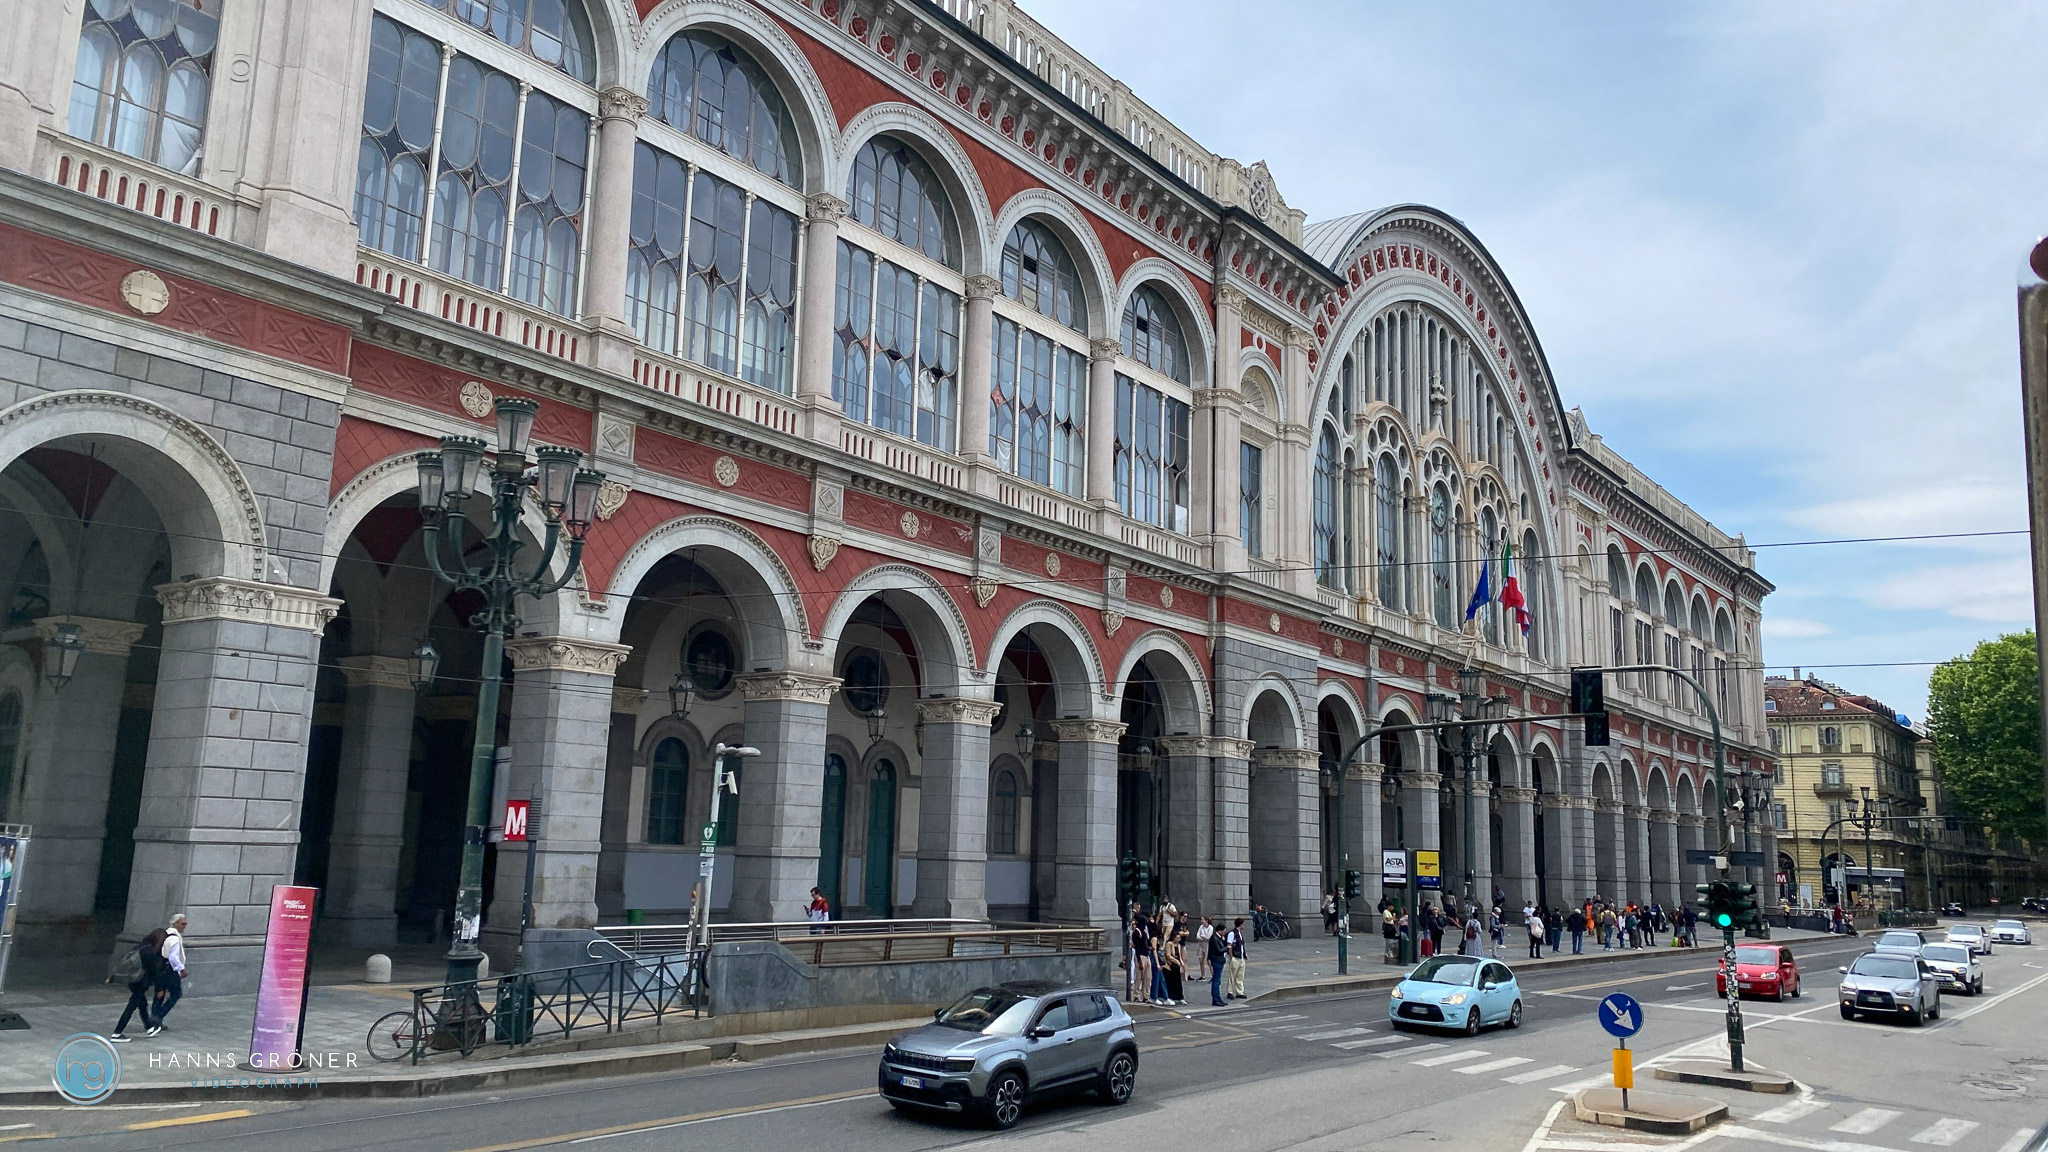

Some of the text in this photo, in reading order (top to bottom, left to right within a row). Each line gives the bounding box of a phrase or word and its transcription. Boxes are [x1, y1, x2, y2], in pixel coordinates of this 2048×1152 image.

[504, 806, 526, 835] M
[1385, 857, 1404, 867] ASTA
[1776, 874, 1787, 883] M
